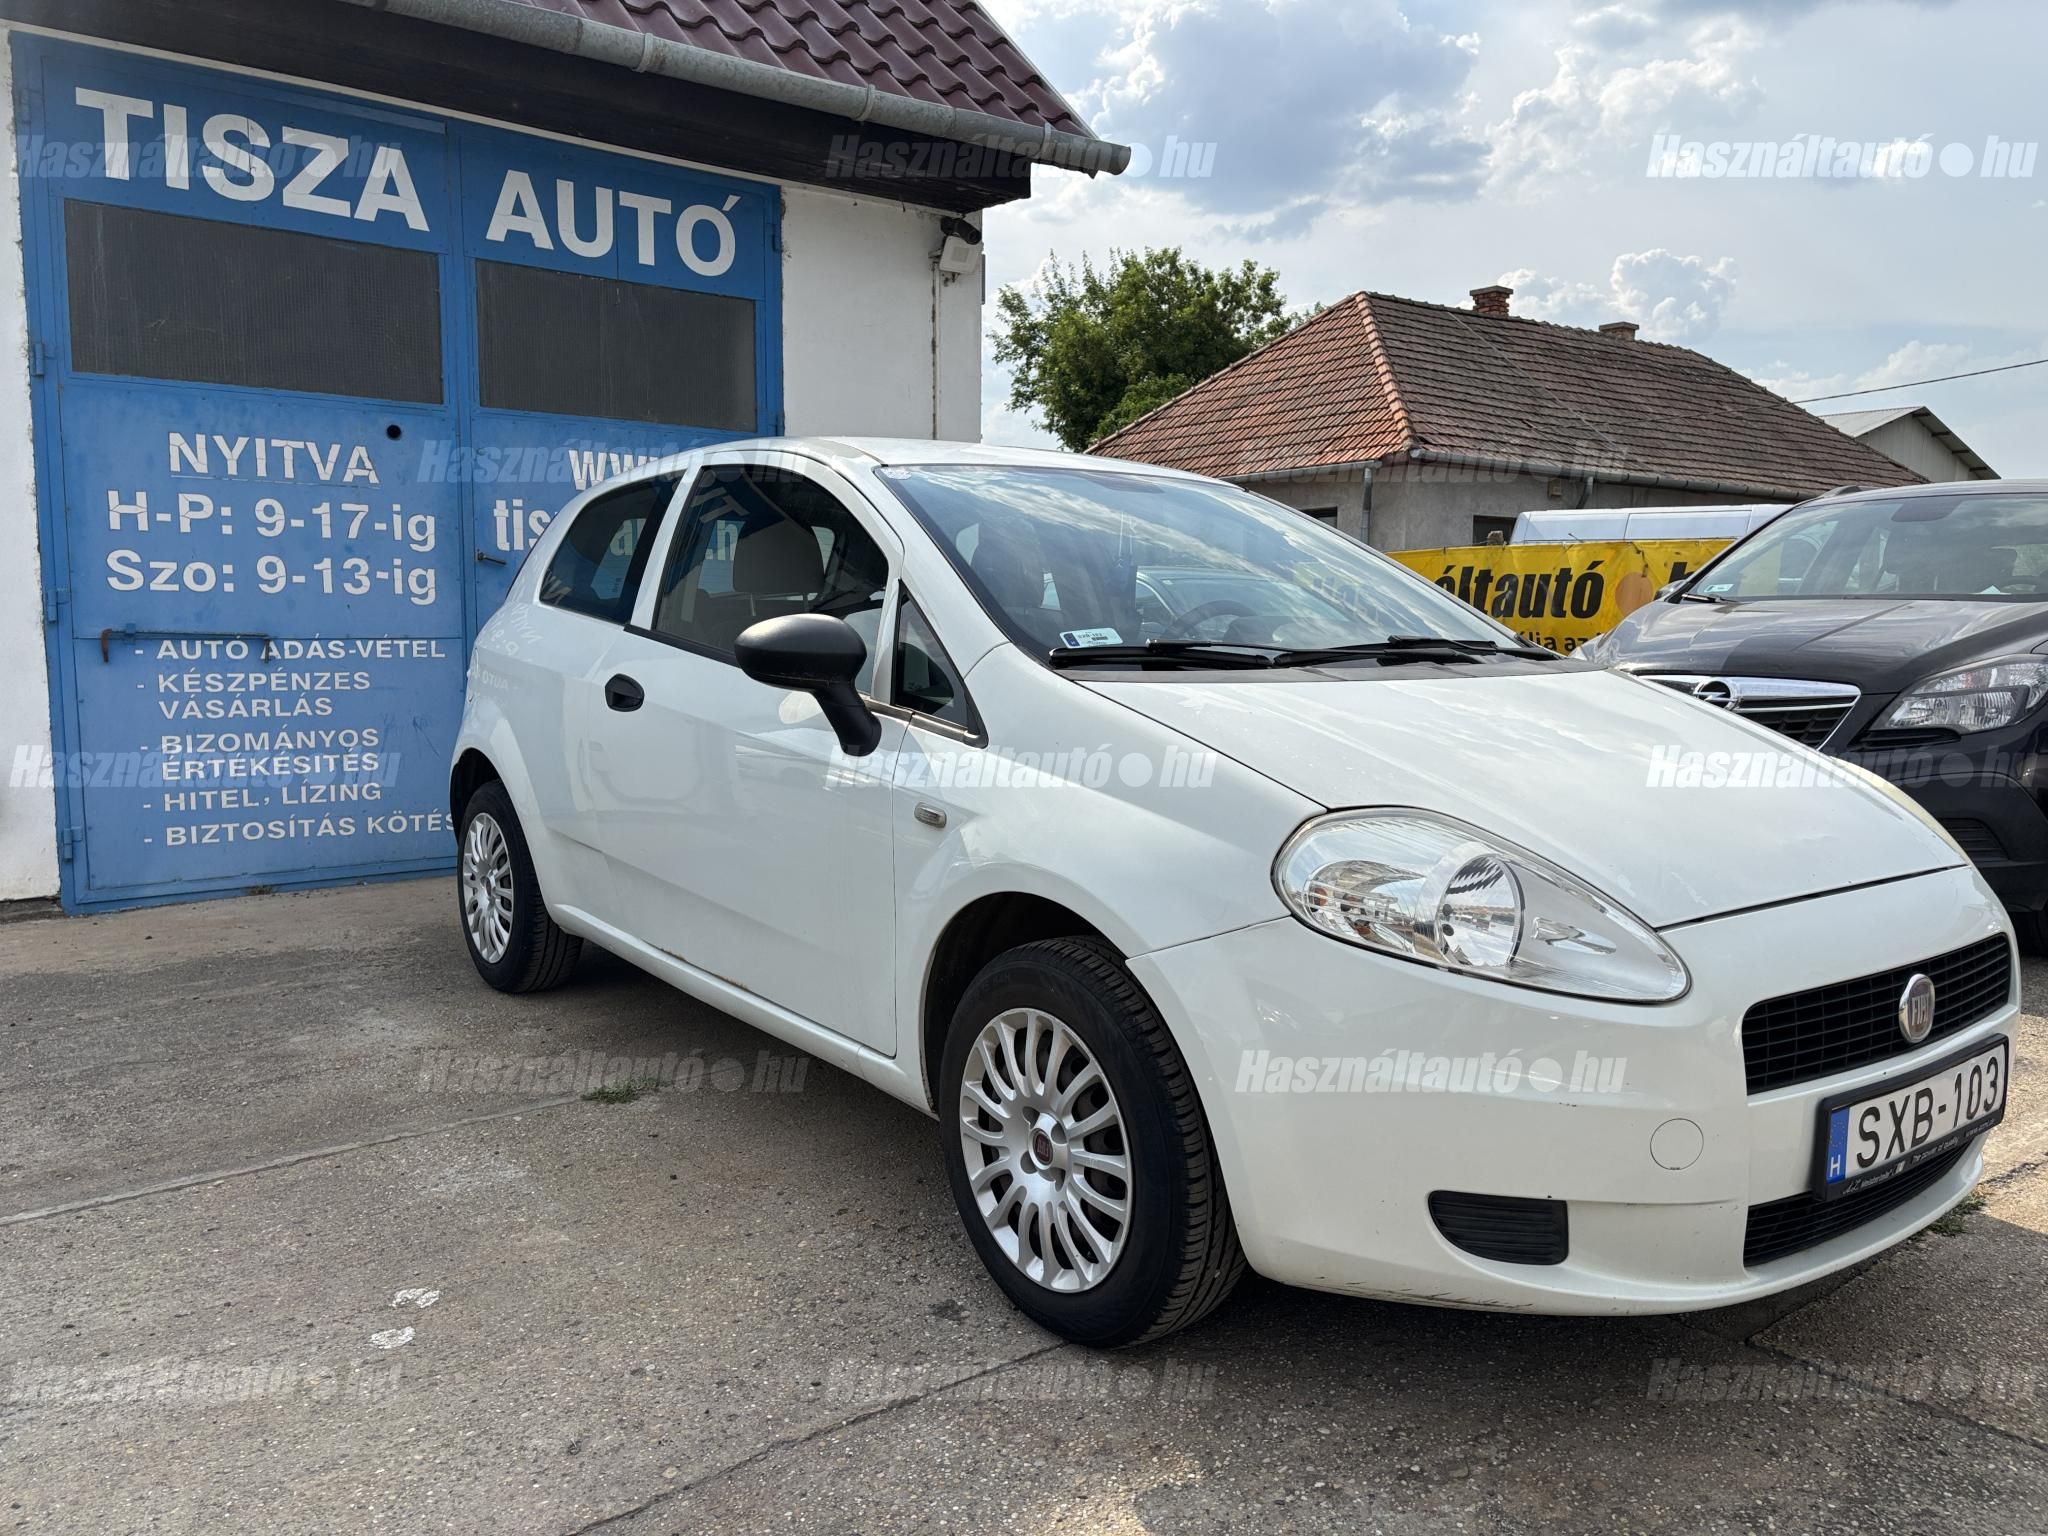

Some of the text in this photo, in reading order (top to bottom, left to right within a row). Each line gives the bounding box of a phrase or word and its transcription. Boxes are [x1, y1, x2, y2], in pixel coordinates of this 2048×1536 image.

[75, 87, 741, 277] TISZA AUTÓ
[168, 432, 380, 484] NYITVA
[107, 490, 436, 552] H-P: 9-17-ig
[493, 499, 557, 551] tis
[106, 549, 436, 606] Szo: 9-13-ig
[156, 635, 249, 660] AUTÓ
[158, 667, 370, 693] KÉSZPÉNZES
[158, 692, 333, 720] VÁSÁRLÁS
[161, 723, 379, 755] BIZOMÁNYOS
[282, 778, 381, 805] LÍZING
[166, 812, 356, 846] BIZTOSÍTÁS
[1829, 1154, 1841, 1178] H
[1856, 1056, 1999, 1169] SXB-103
